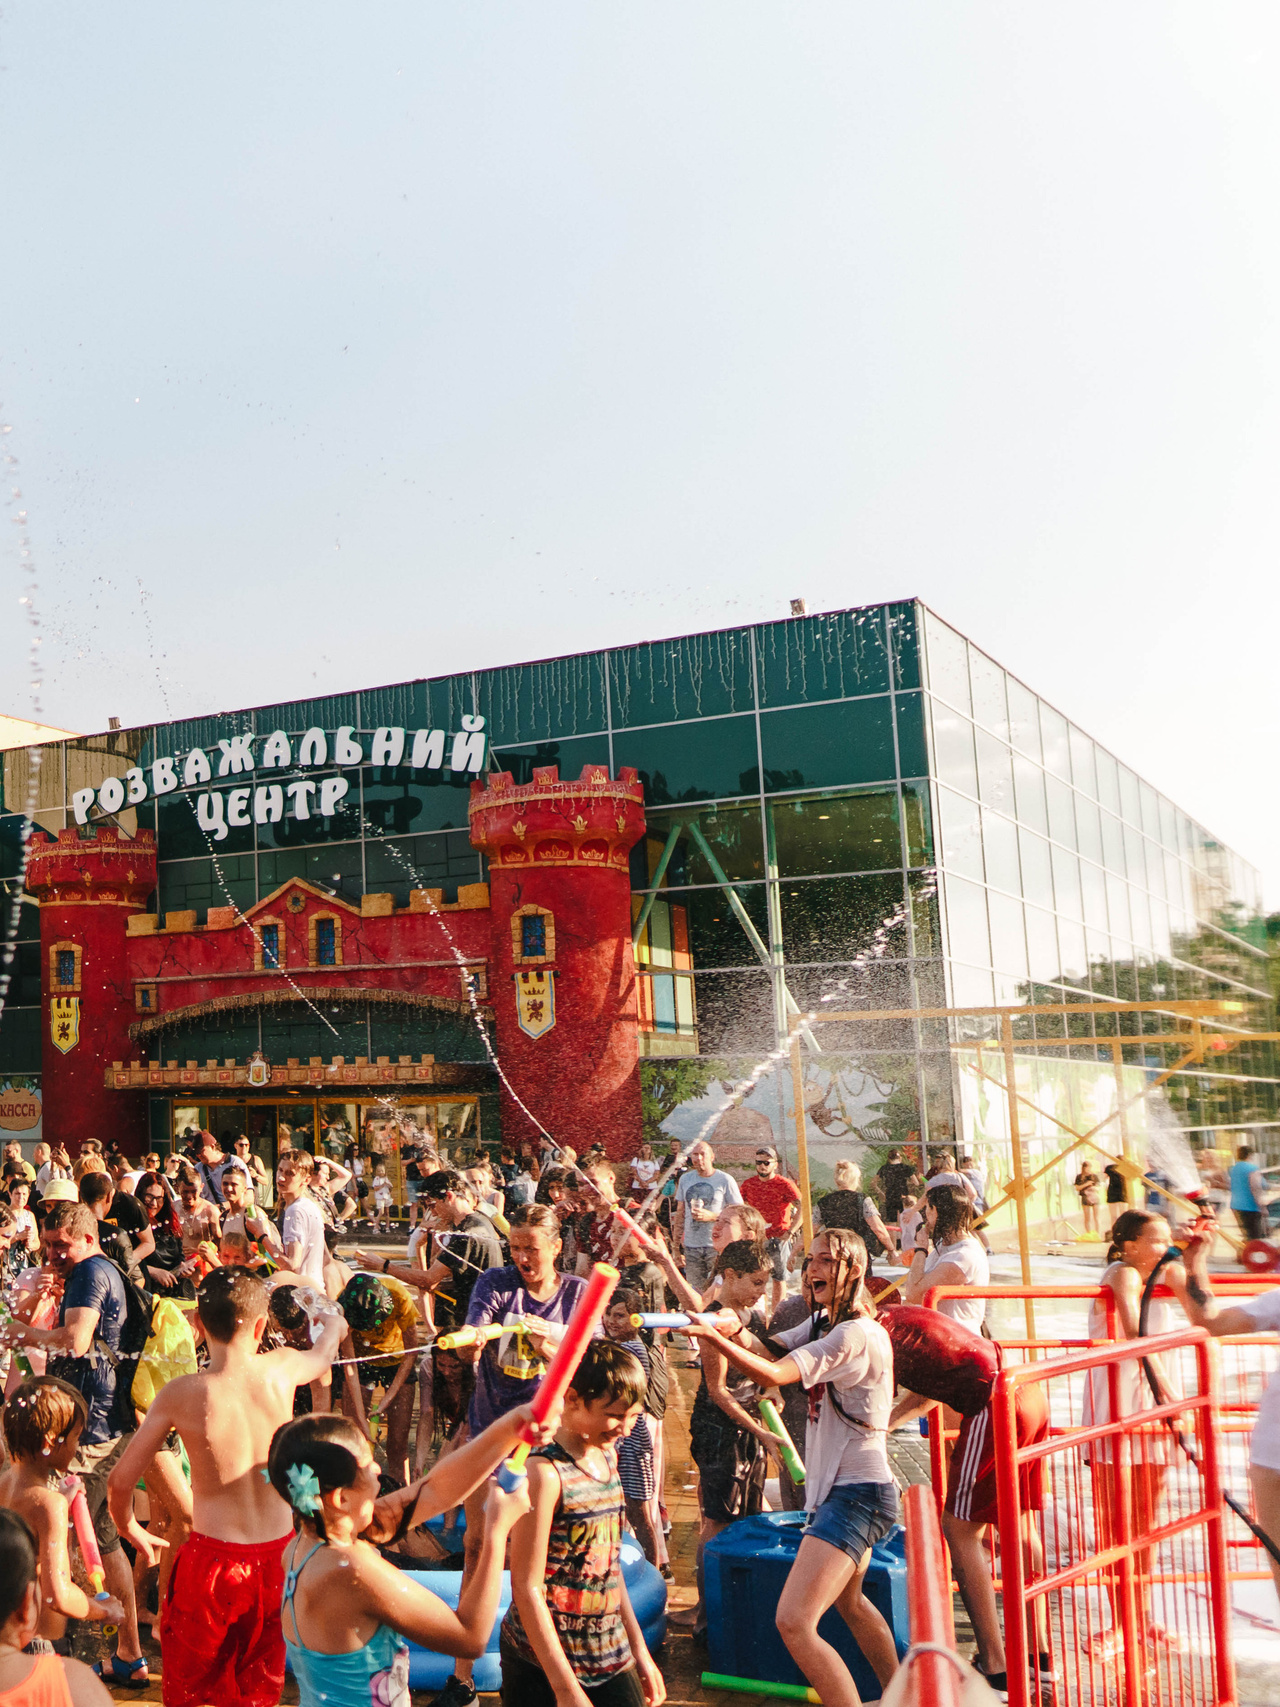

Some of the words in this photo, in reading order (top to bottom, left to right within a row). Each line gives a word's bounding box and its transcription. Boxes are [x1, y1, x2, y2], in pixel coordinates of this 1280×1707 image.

[73, 714, 487, 825] РОЗВАЖАЛЬНИЙ
[197, 777, 349, 841] ЦЕНТР
[0, 1104, 36, 1117] КАССА
